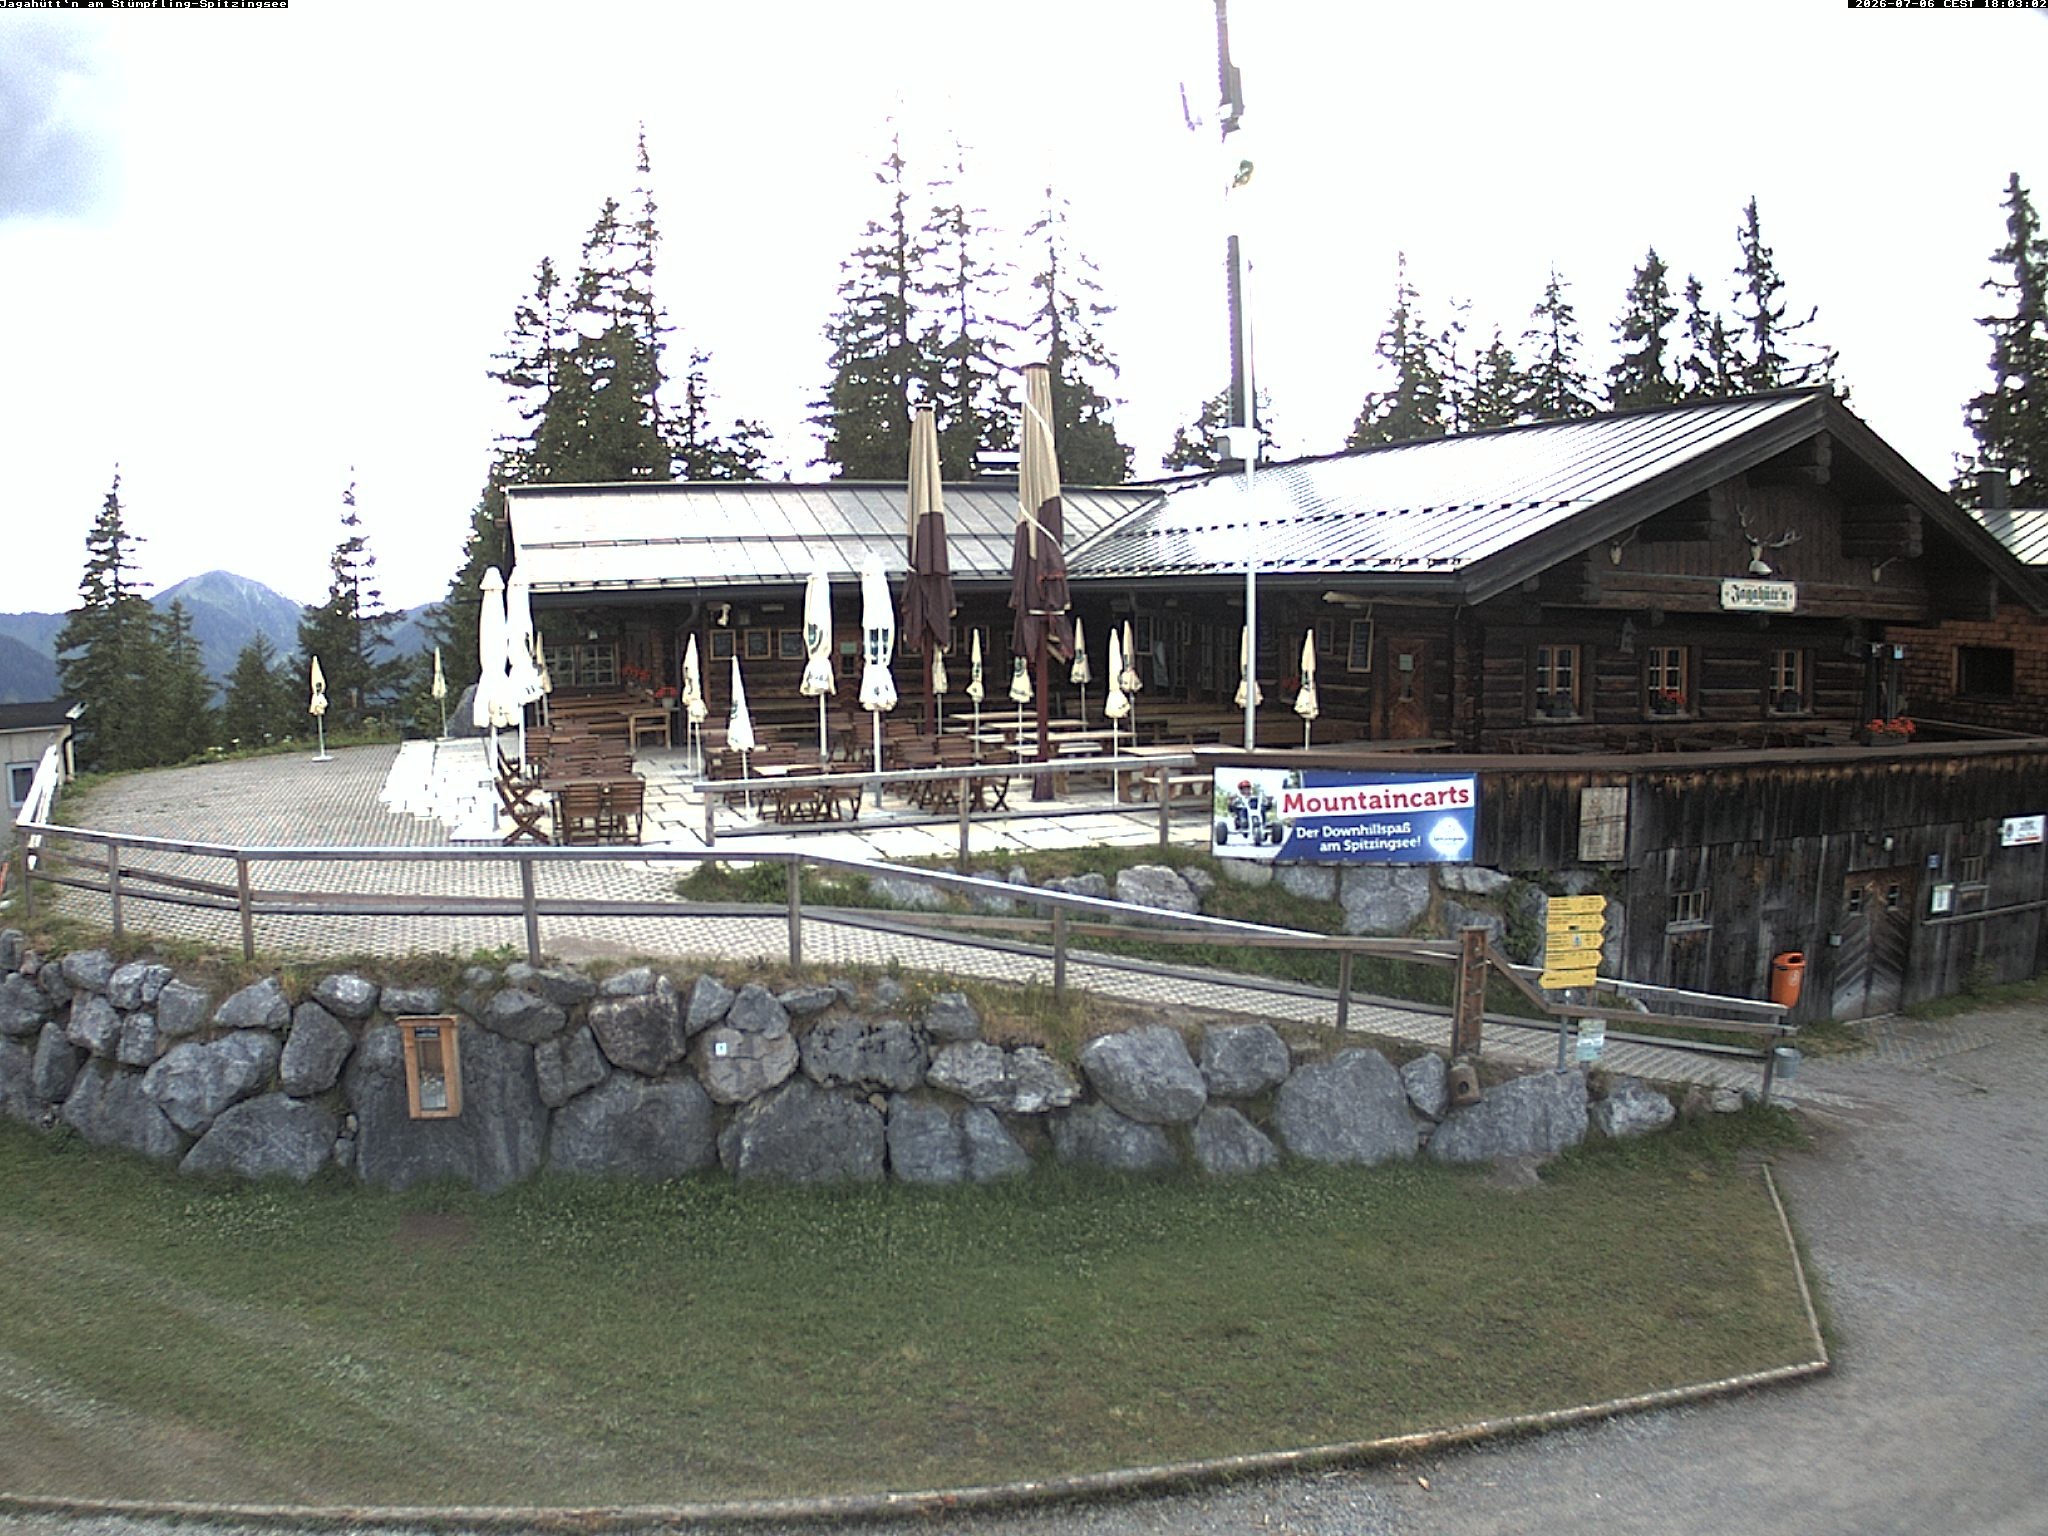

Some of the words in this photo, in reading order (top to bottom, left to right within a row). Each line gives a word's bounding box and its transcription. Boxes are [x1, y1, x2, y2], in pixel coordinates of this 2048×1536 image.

[1283, 786, 1470, 813] Mountaincarts
[1296, 826, 1319, 839] Der
[1322, 822, 1411, 839] Downhillspaß
[1319, 840, 1341, 852] am
[1343, 836, 1421, 854] Spitzingsee!
